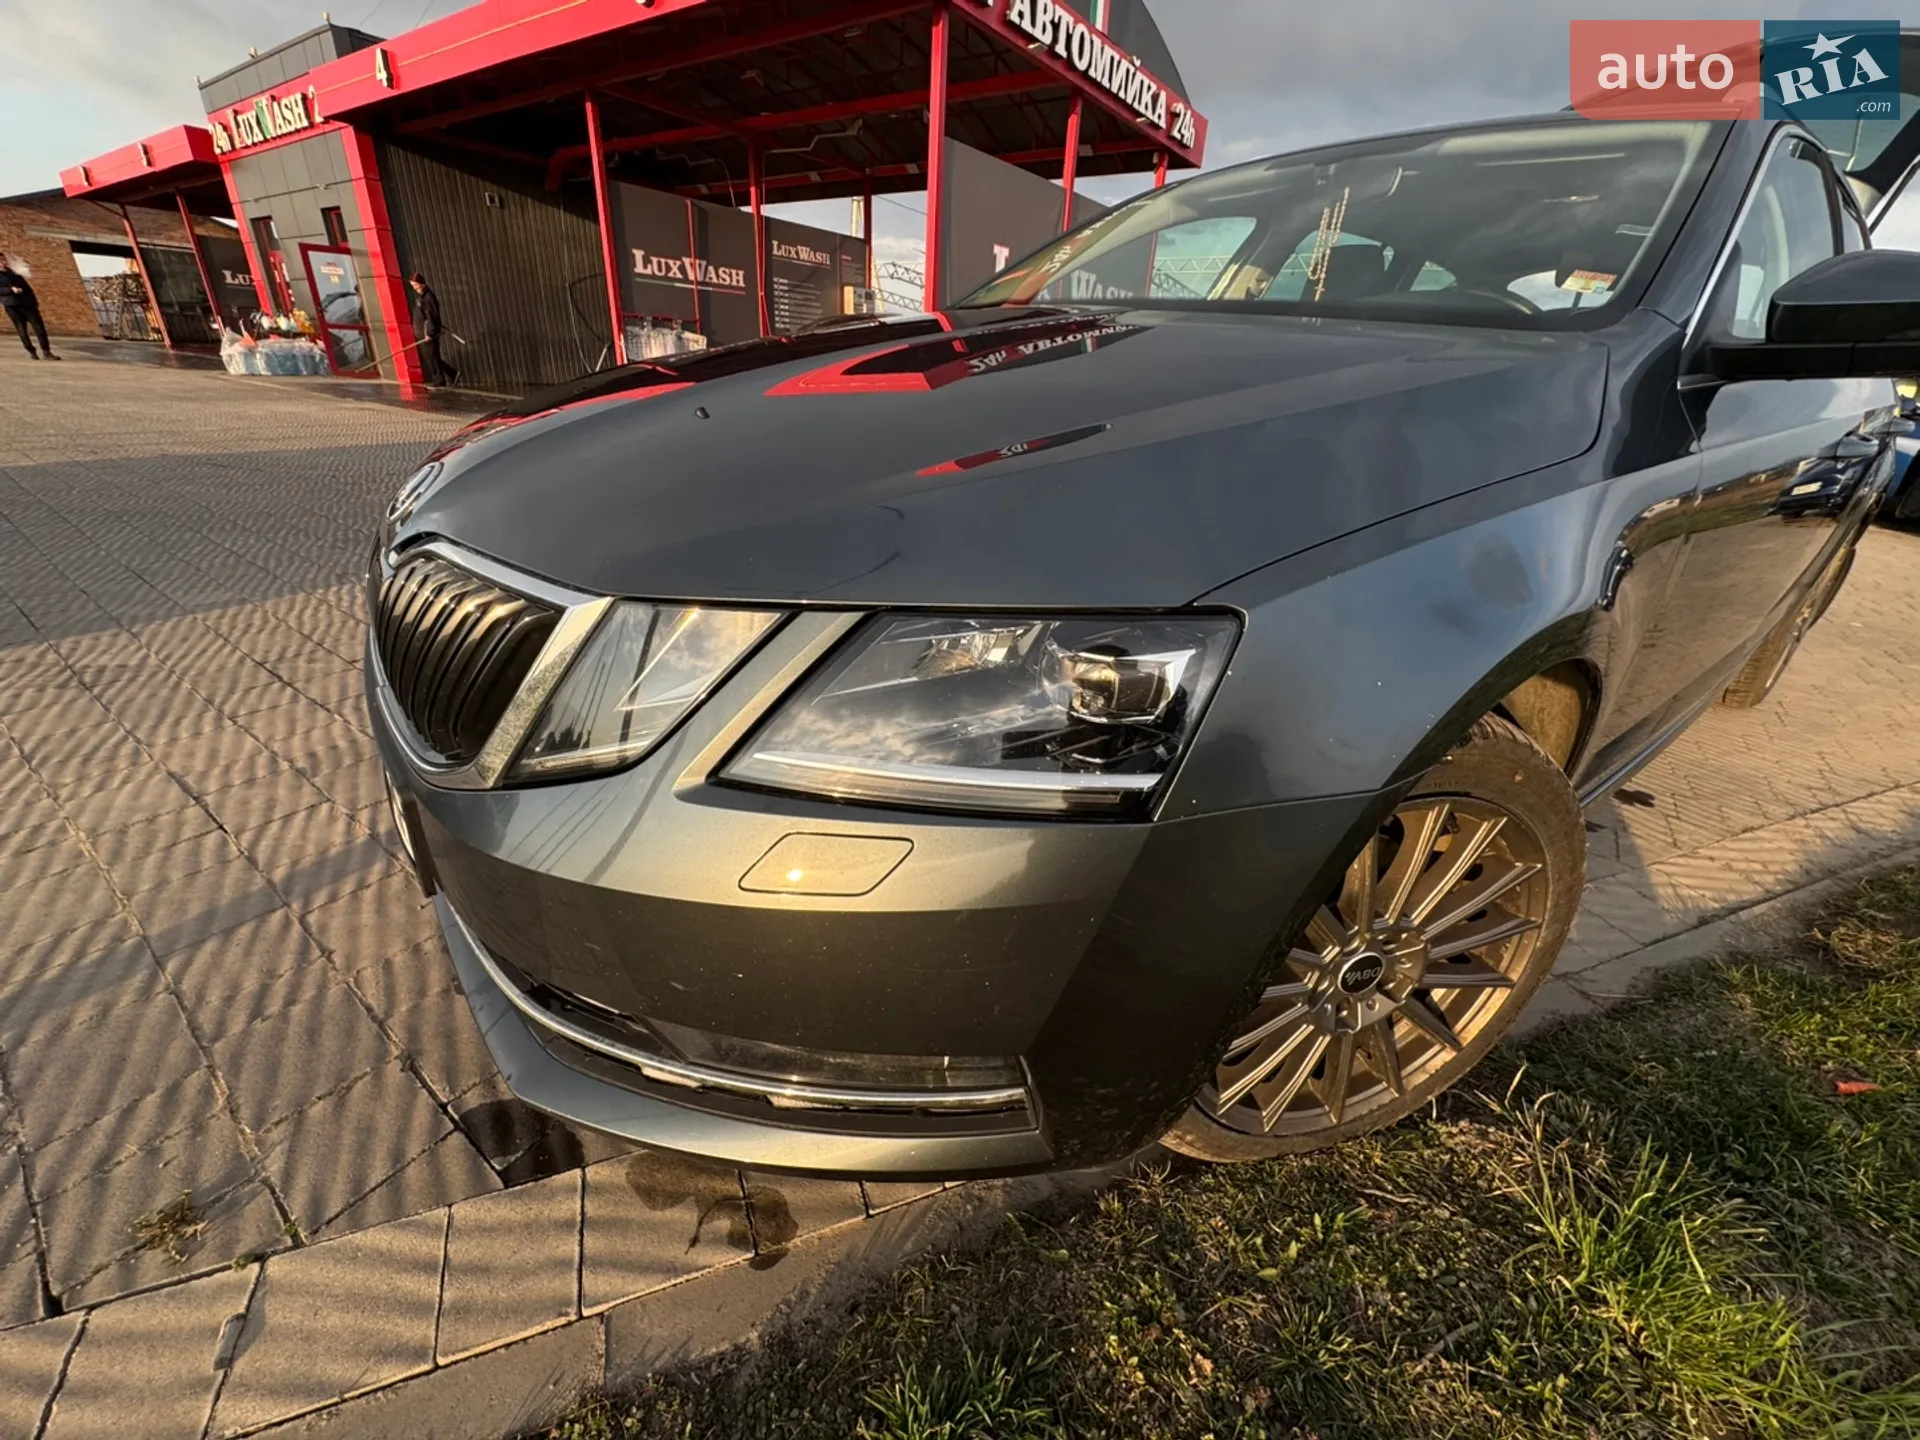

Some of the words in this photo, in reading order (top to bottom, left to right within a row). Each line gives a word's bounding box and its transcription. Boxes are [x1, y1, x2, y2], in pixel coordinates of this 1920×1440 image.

[375, 47, 390, 88] 4
[1009, 0, 1167, 129] АВТОМИЙКА
[1171, 102, 1196, 149] 24h
[208, 121, 232, 155] 24h
